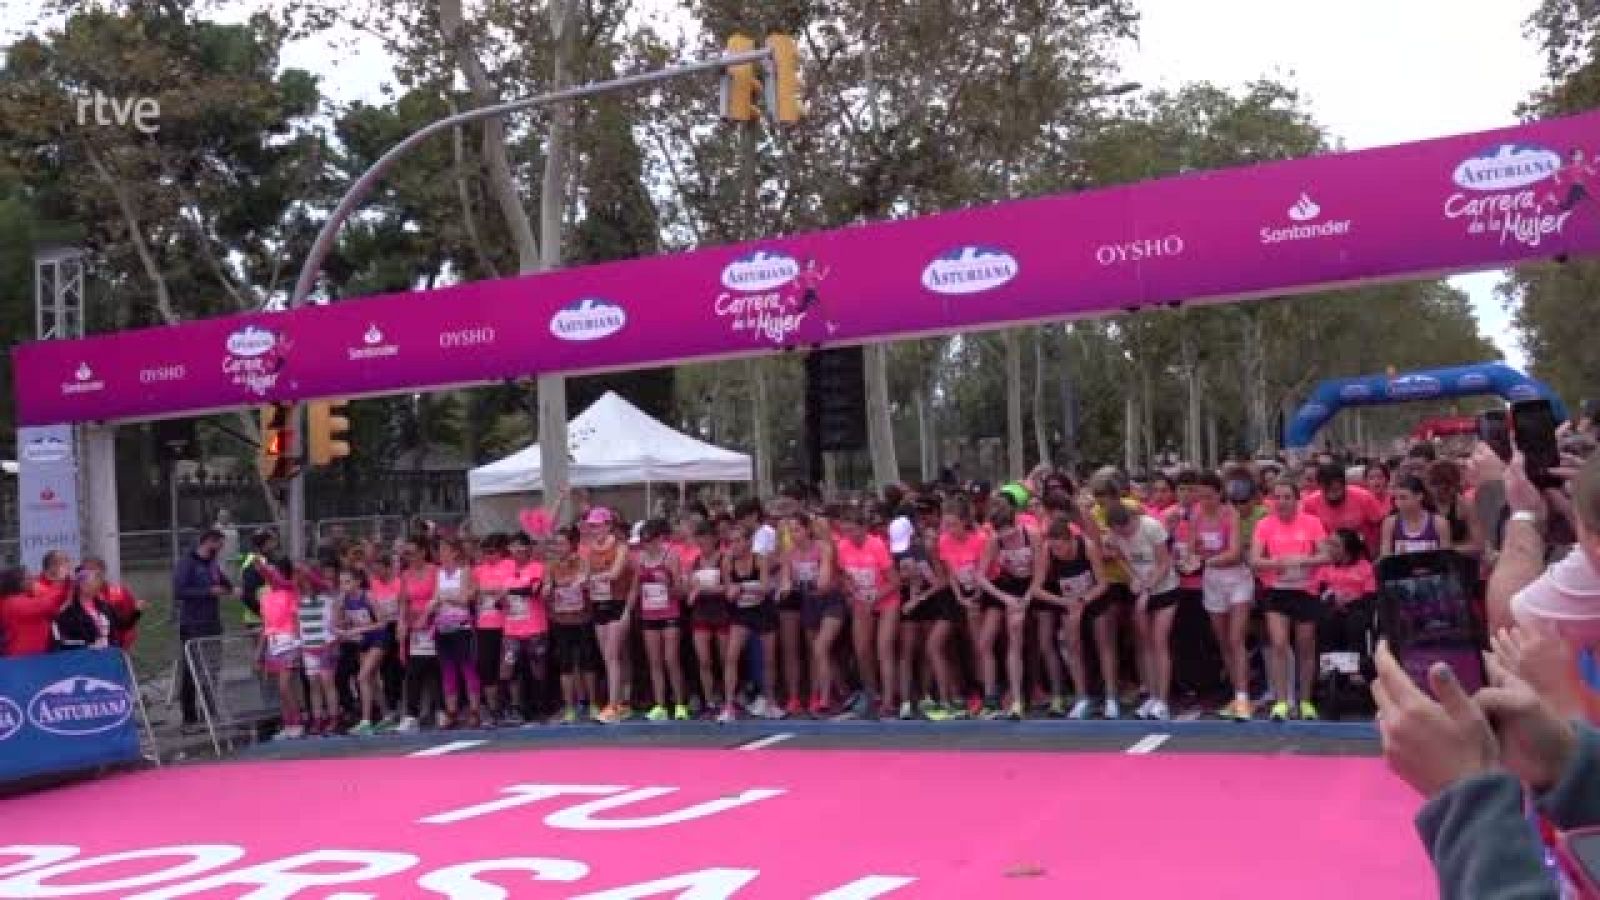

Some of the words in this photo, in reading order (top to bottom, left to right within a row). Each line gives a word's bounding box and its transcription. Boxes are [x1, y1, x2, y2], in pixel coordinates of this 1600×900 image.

[1462, 158, 1553, 185] ASTURIANA
[1444, 190, 1540, 219] Carrera
[1260, 219, 1351, 244] Santander
[1467, 213, 1486, 234] de
[1500, 205, 1572, 247] Mujer
[1096, 235, 1184, 266] OYSHO
[929, 263, 1011, 286] ASTURIANA
[715, 293, 786, 315] Carrera
[439, 327, 496, 349] OYSHO
[755, 308, 807, 343] Mujer
[39, 699, 126, 723] ASTURIANA
[415, 784, 790, 829] TU
